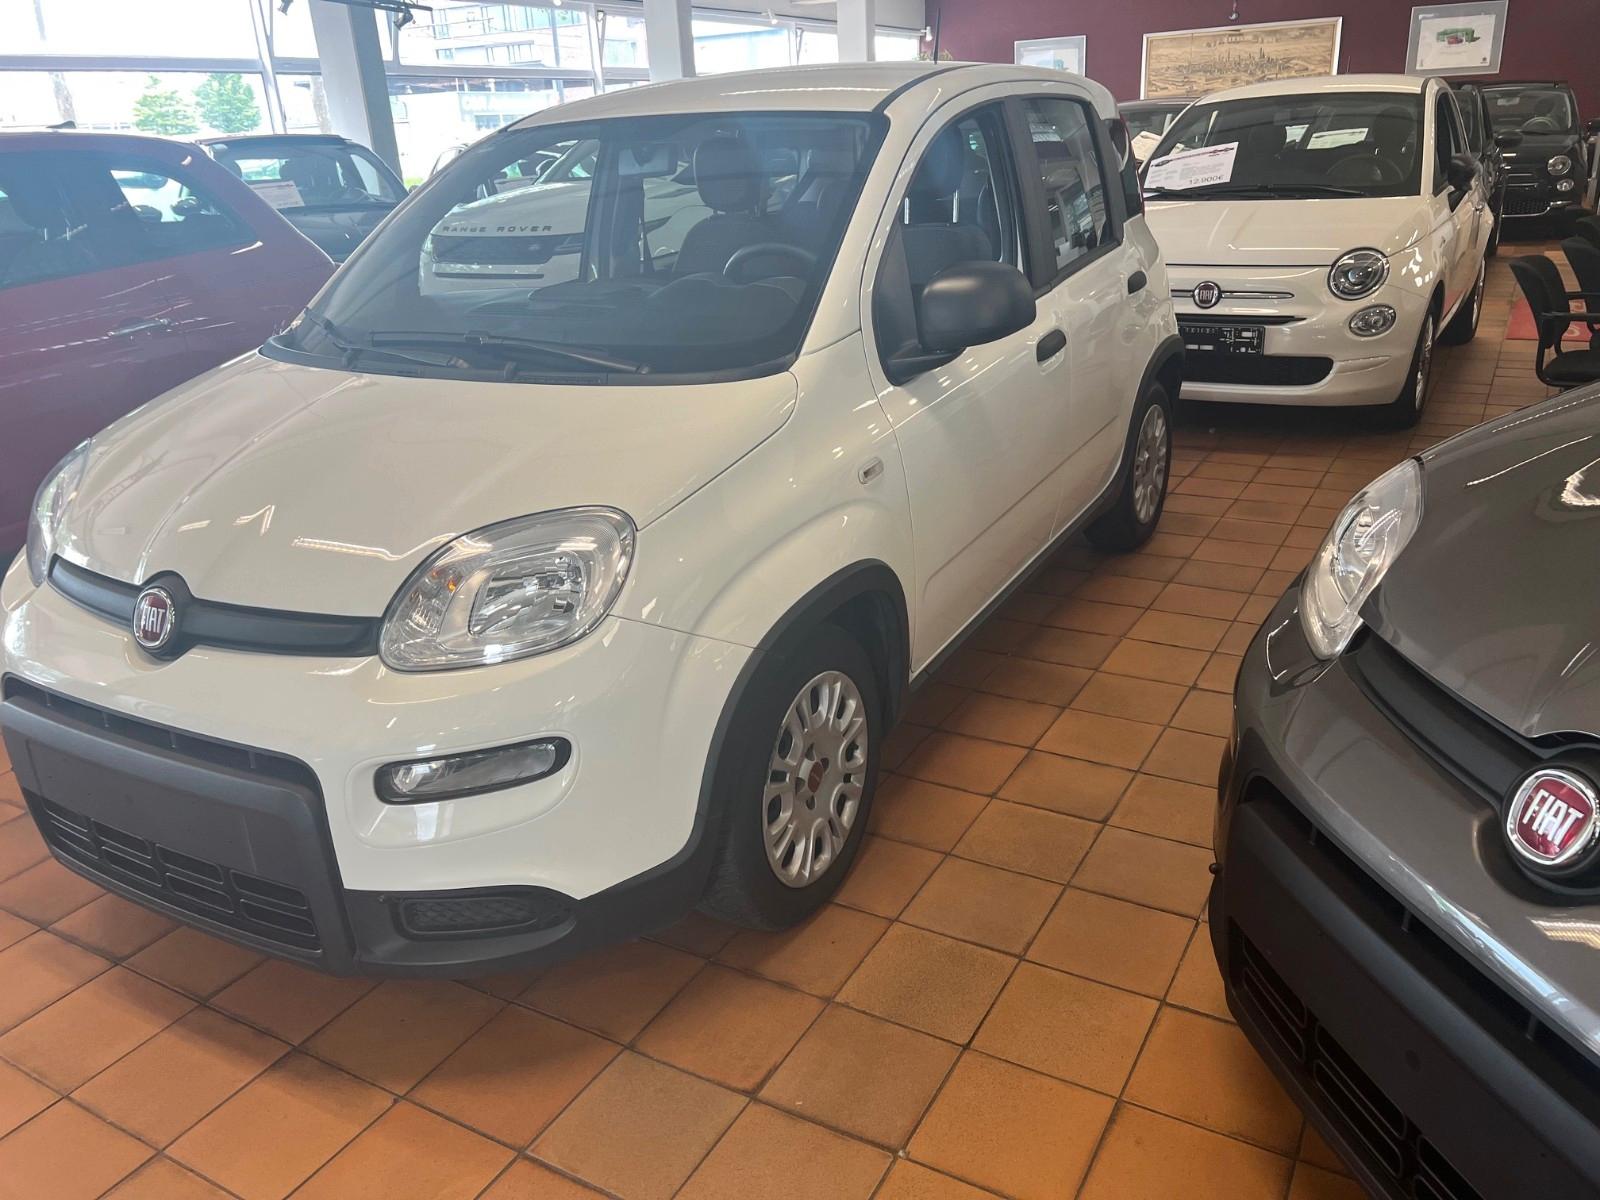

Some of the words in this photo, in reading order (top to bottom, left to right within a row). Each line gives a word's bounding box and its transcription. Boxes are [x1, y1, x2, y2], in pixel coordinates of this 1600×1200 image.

[496, 225, 553, 233] ROVER
[1199, 289, 1215, 301] FIAT
[140, 605, 165, 633] FIAT
[1522, 788, 1585, 847] FIAT
